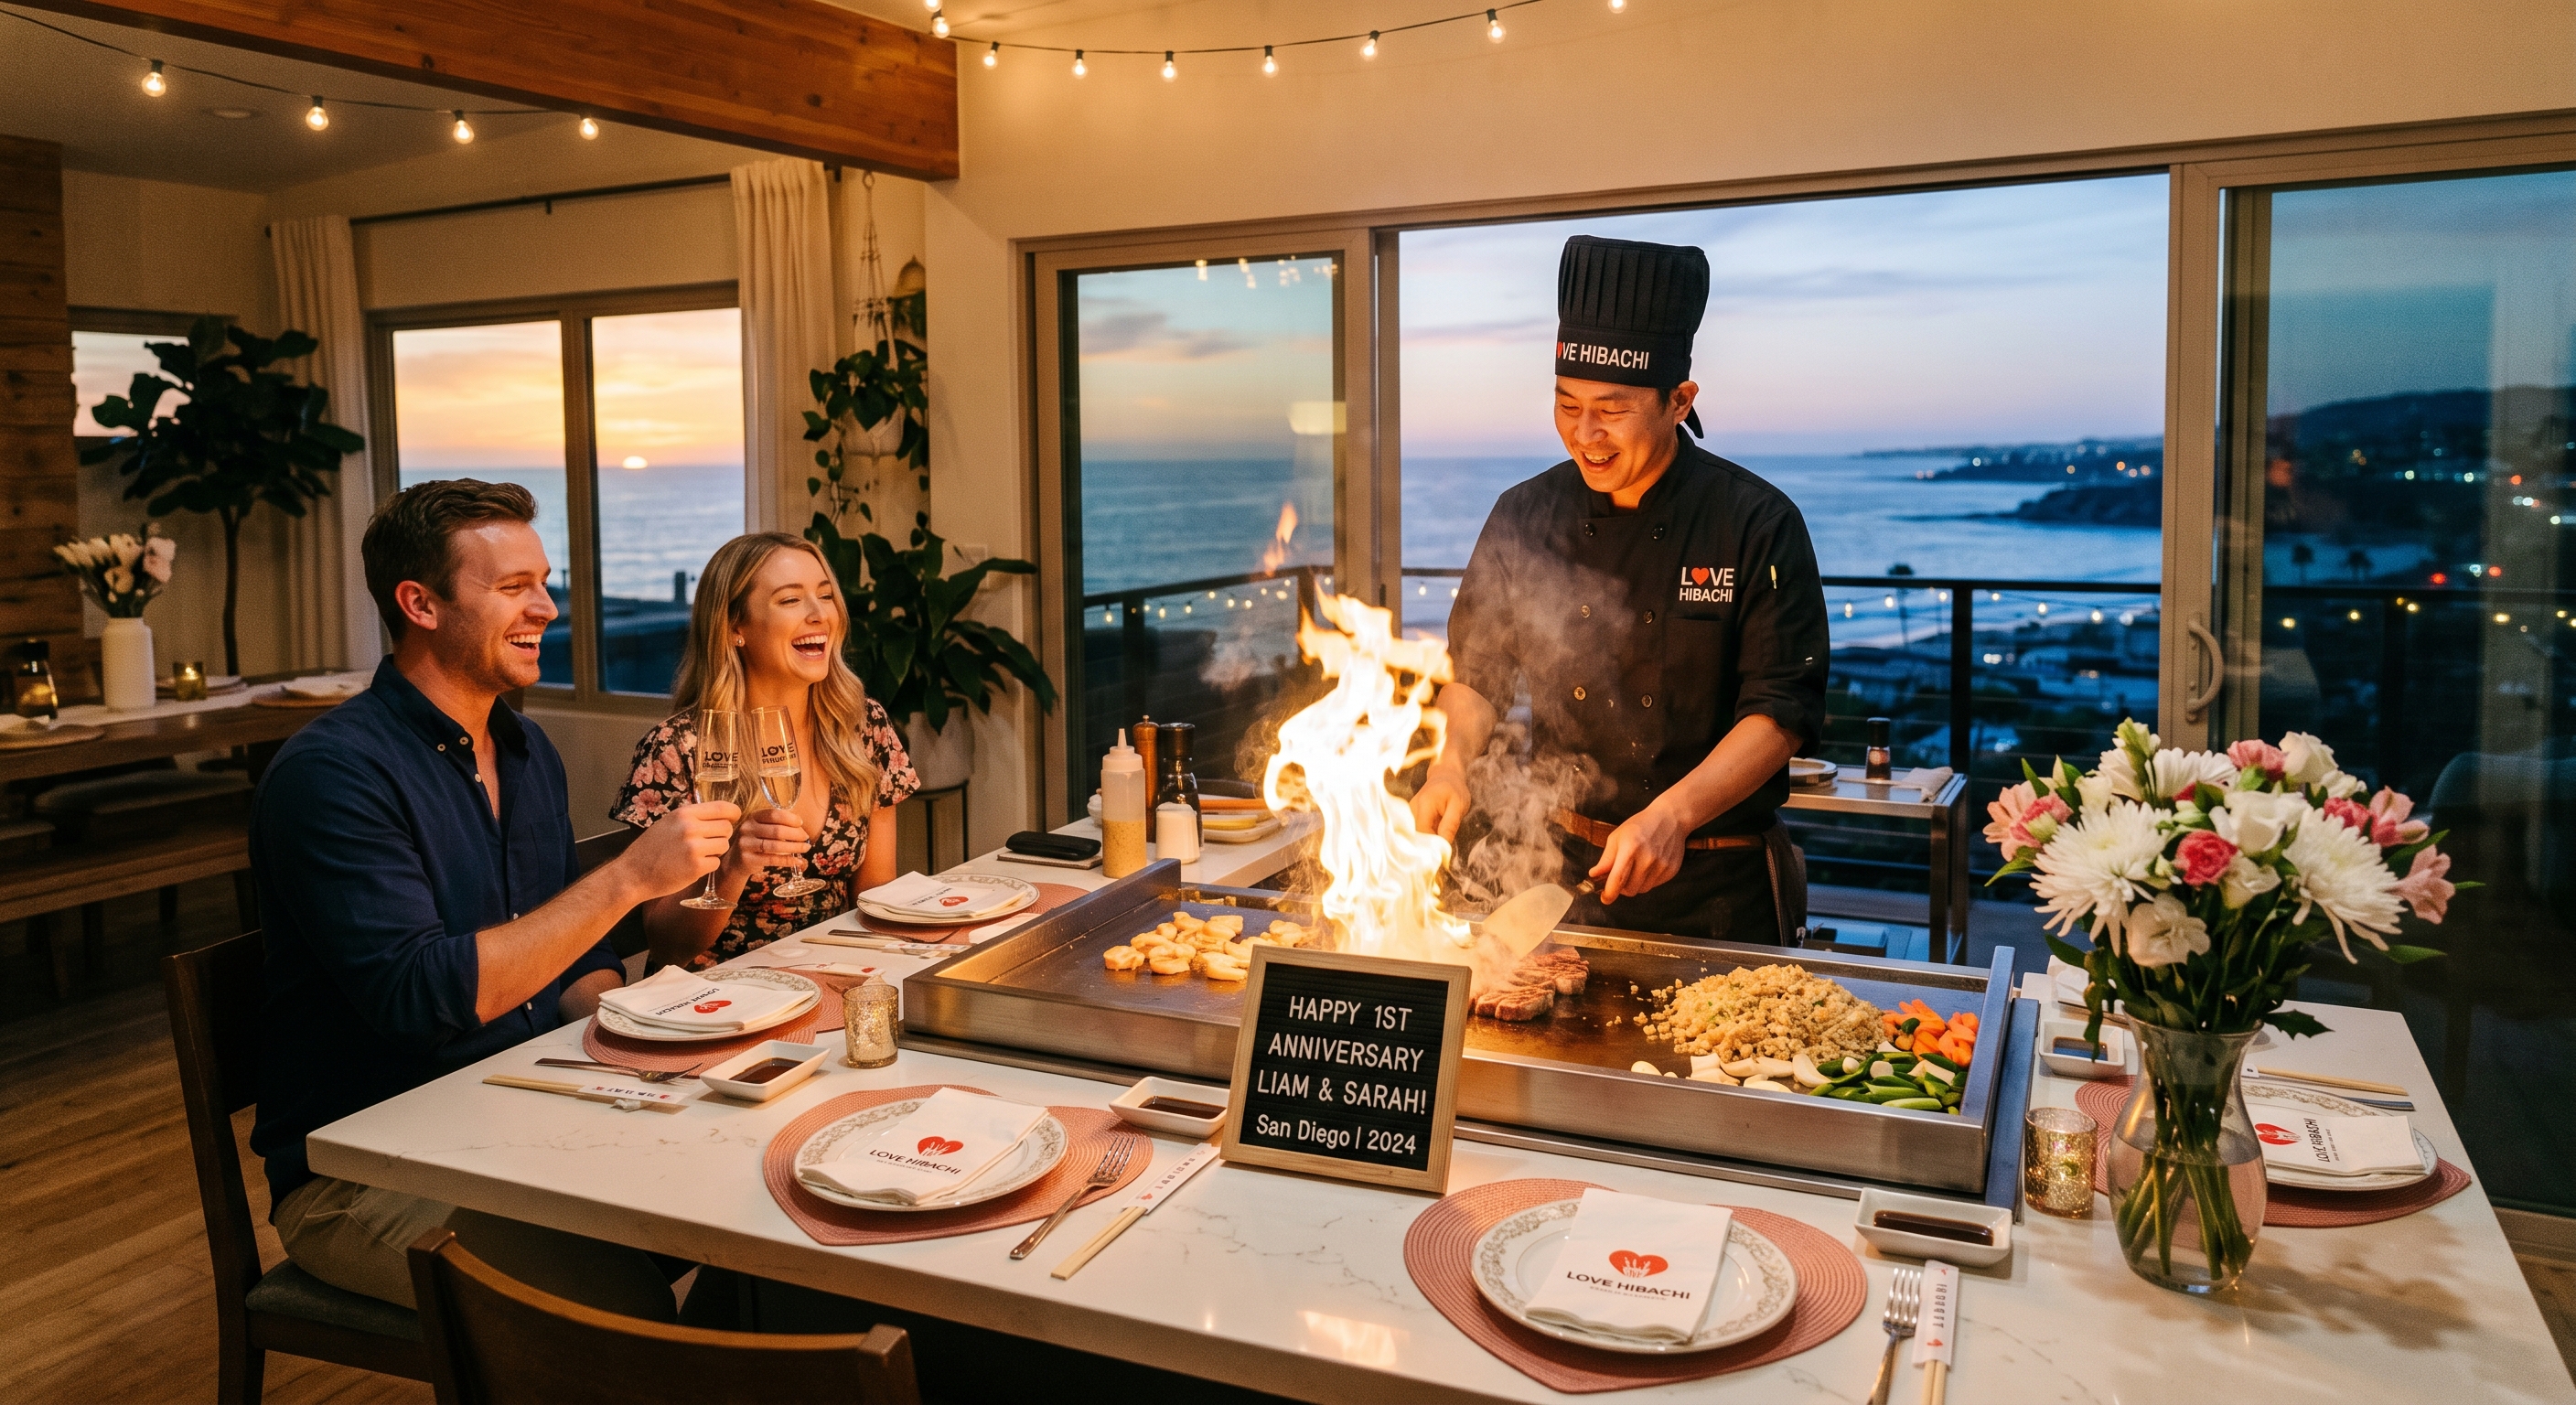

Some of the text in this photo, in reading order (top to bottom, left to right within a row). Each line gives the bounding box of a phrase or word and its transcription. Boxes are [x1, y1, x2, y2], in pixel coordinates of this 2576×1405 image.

[1580, 344, 1649, 370] HIBACHI
[1679, 587, 1733, 603] HIBACHI
[704, 751, 738, 762] LOVE
[761, 742, 794, 758] LOVE
[1289, 995, 1413, 1032] HAPPY 1ST
[1267, 1032, 1424, 1073] ANNIVERSARY
[1257, 1069, 1427, 1115] LIAM & SARAH!
[1256, 1113, 1292, 1138] San
[1297, 1120, 1351, 1150] Diego
[1367, 1130, 1417, 1155] 2024
[869, 1149, 906, 1163] LOVE
[1567, 1271, 1614, 1288] LOVE
[1617, 1282, 1690, 1300] HIBACHI
